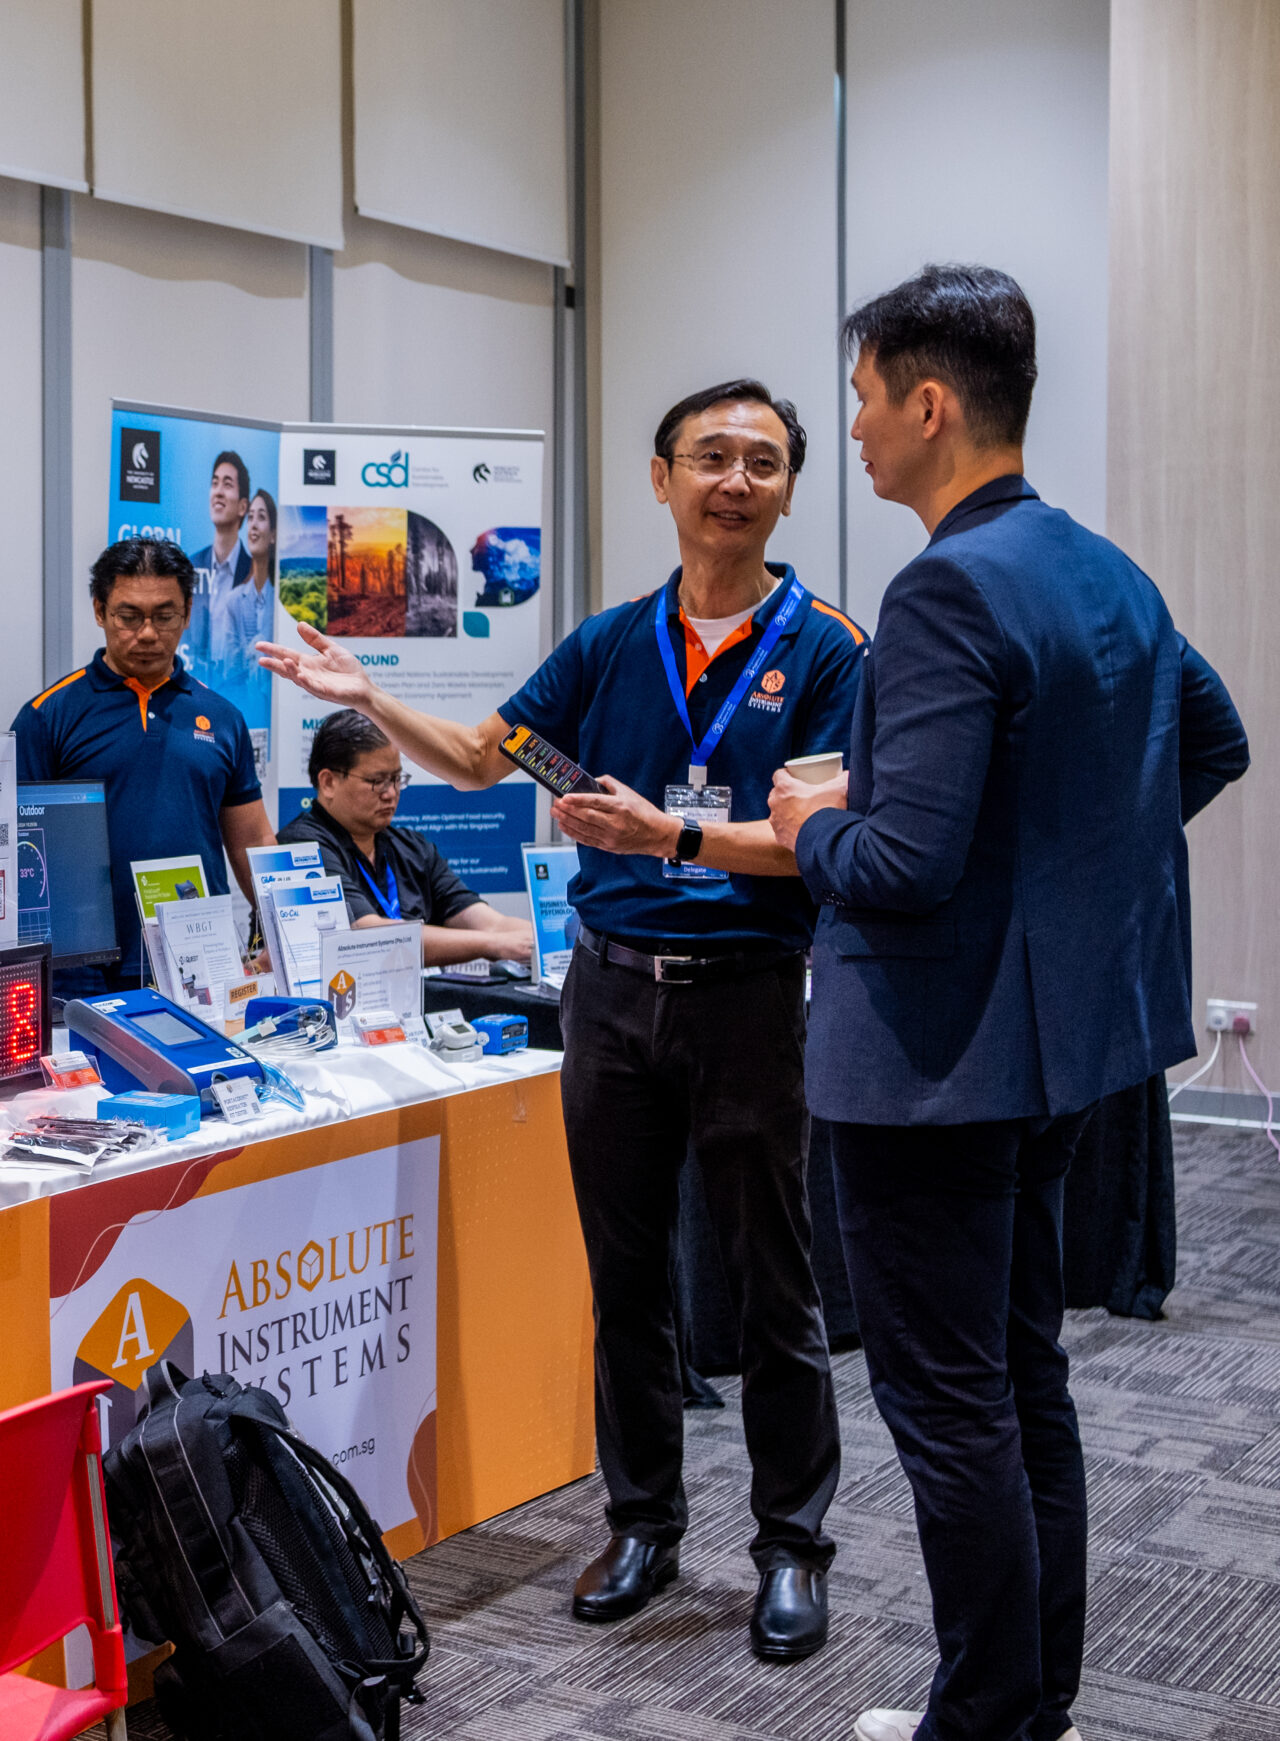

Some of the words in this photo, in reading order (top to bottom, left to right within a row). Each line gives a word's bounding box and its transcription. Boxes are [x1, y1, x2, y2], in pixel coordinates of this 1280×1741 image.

[361, 451, 409, 488] csd
[19, 805, 45, 816] Outdoor
[683, 866, 707, 874] Delegate
[186, 920, 212, 934] WBGT
[231, 983, 257, 999] REGISTER
[337, 972, 347, 990] A
[345, 990, 353, 1012] S
[217, 1213, 416, 1320] ABSOLUTE
[111, 1291, 155, 1369] A
[217, 1274, 414, 1376] INSTRUMENT
